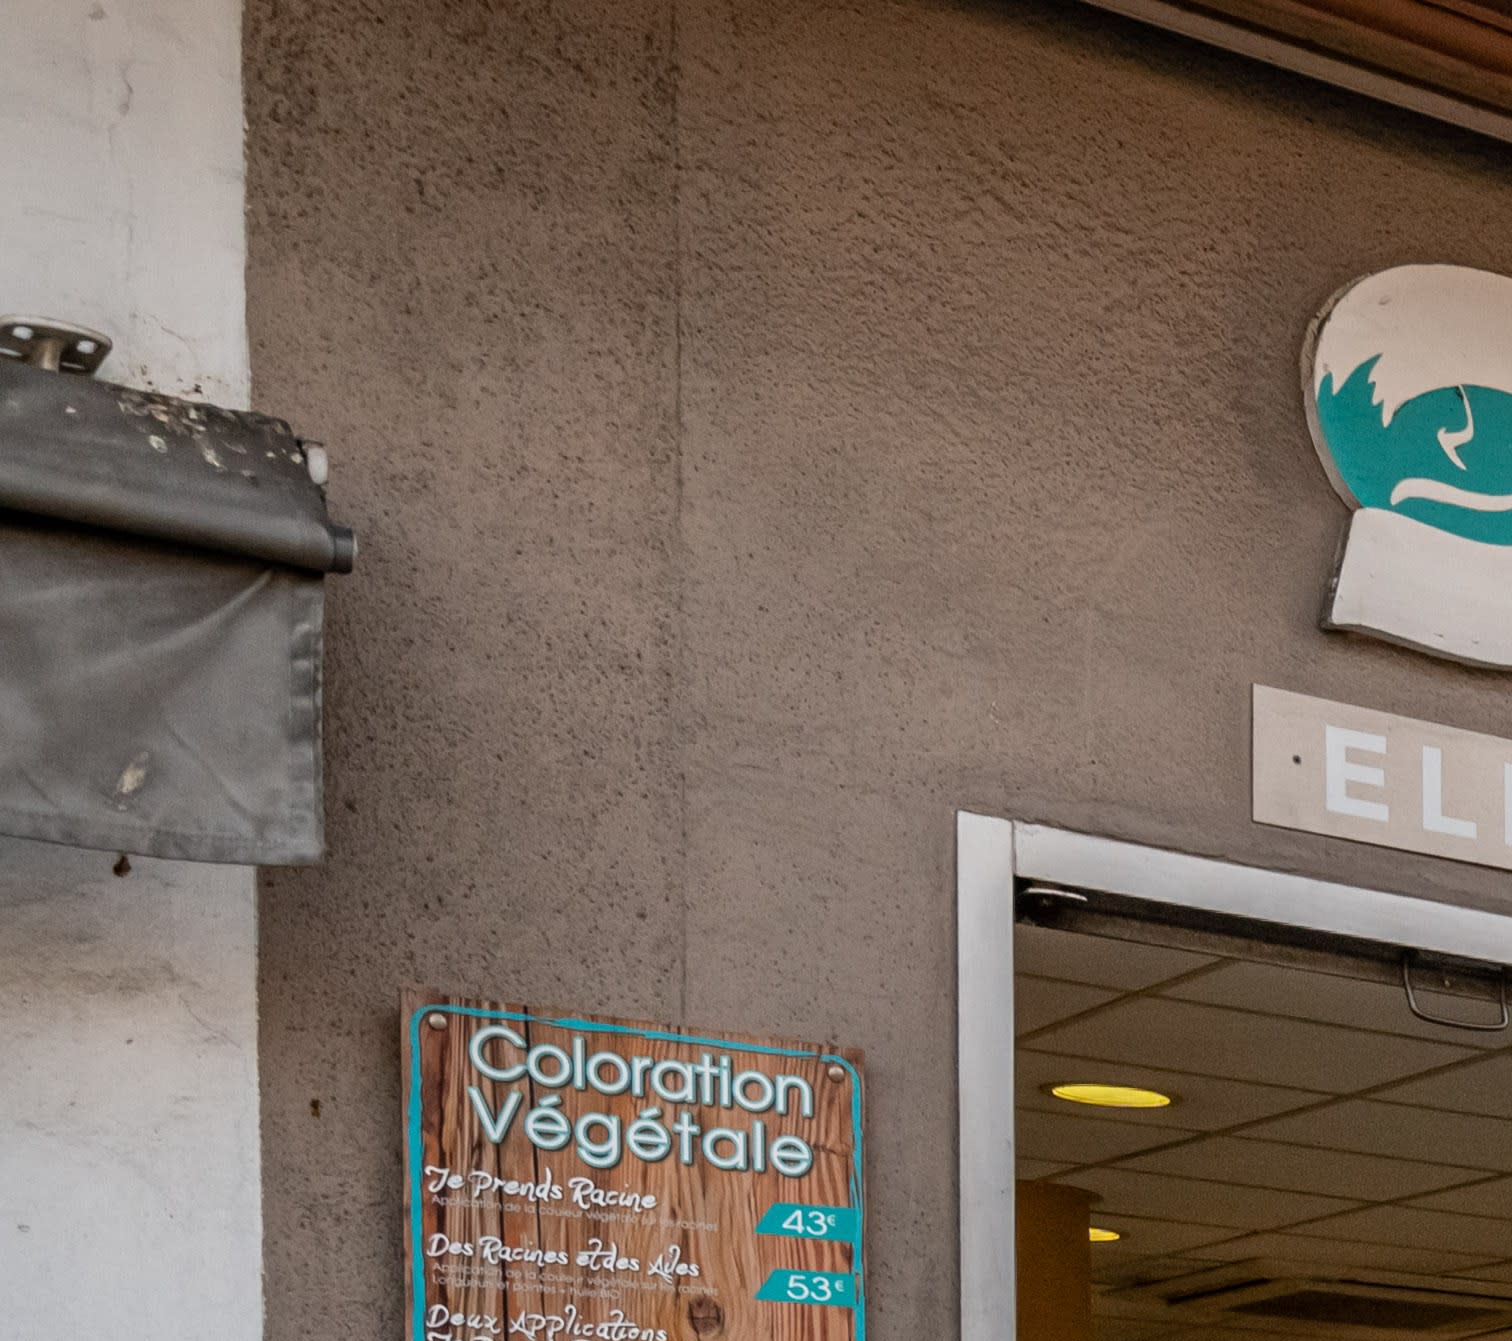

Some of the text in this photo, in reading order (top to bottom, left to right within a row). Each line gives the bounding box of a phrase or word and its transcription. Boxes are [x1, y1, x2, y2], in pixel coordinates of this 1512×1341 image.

[468, 1024, 815, 1118] Coloration
[467, 1086, 815, 1178] Végétale
[568, 1176, 657, 1213] Racine
[782, 1209, 836, 1236] 43€
[426, 1232, 474, 1258] Des
[479, 1235, 569, 1266] Racines
[786, 1275, 844, 1302] 53€
[426, 1303, 501, 1334] Deux
